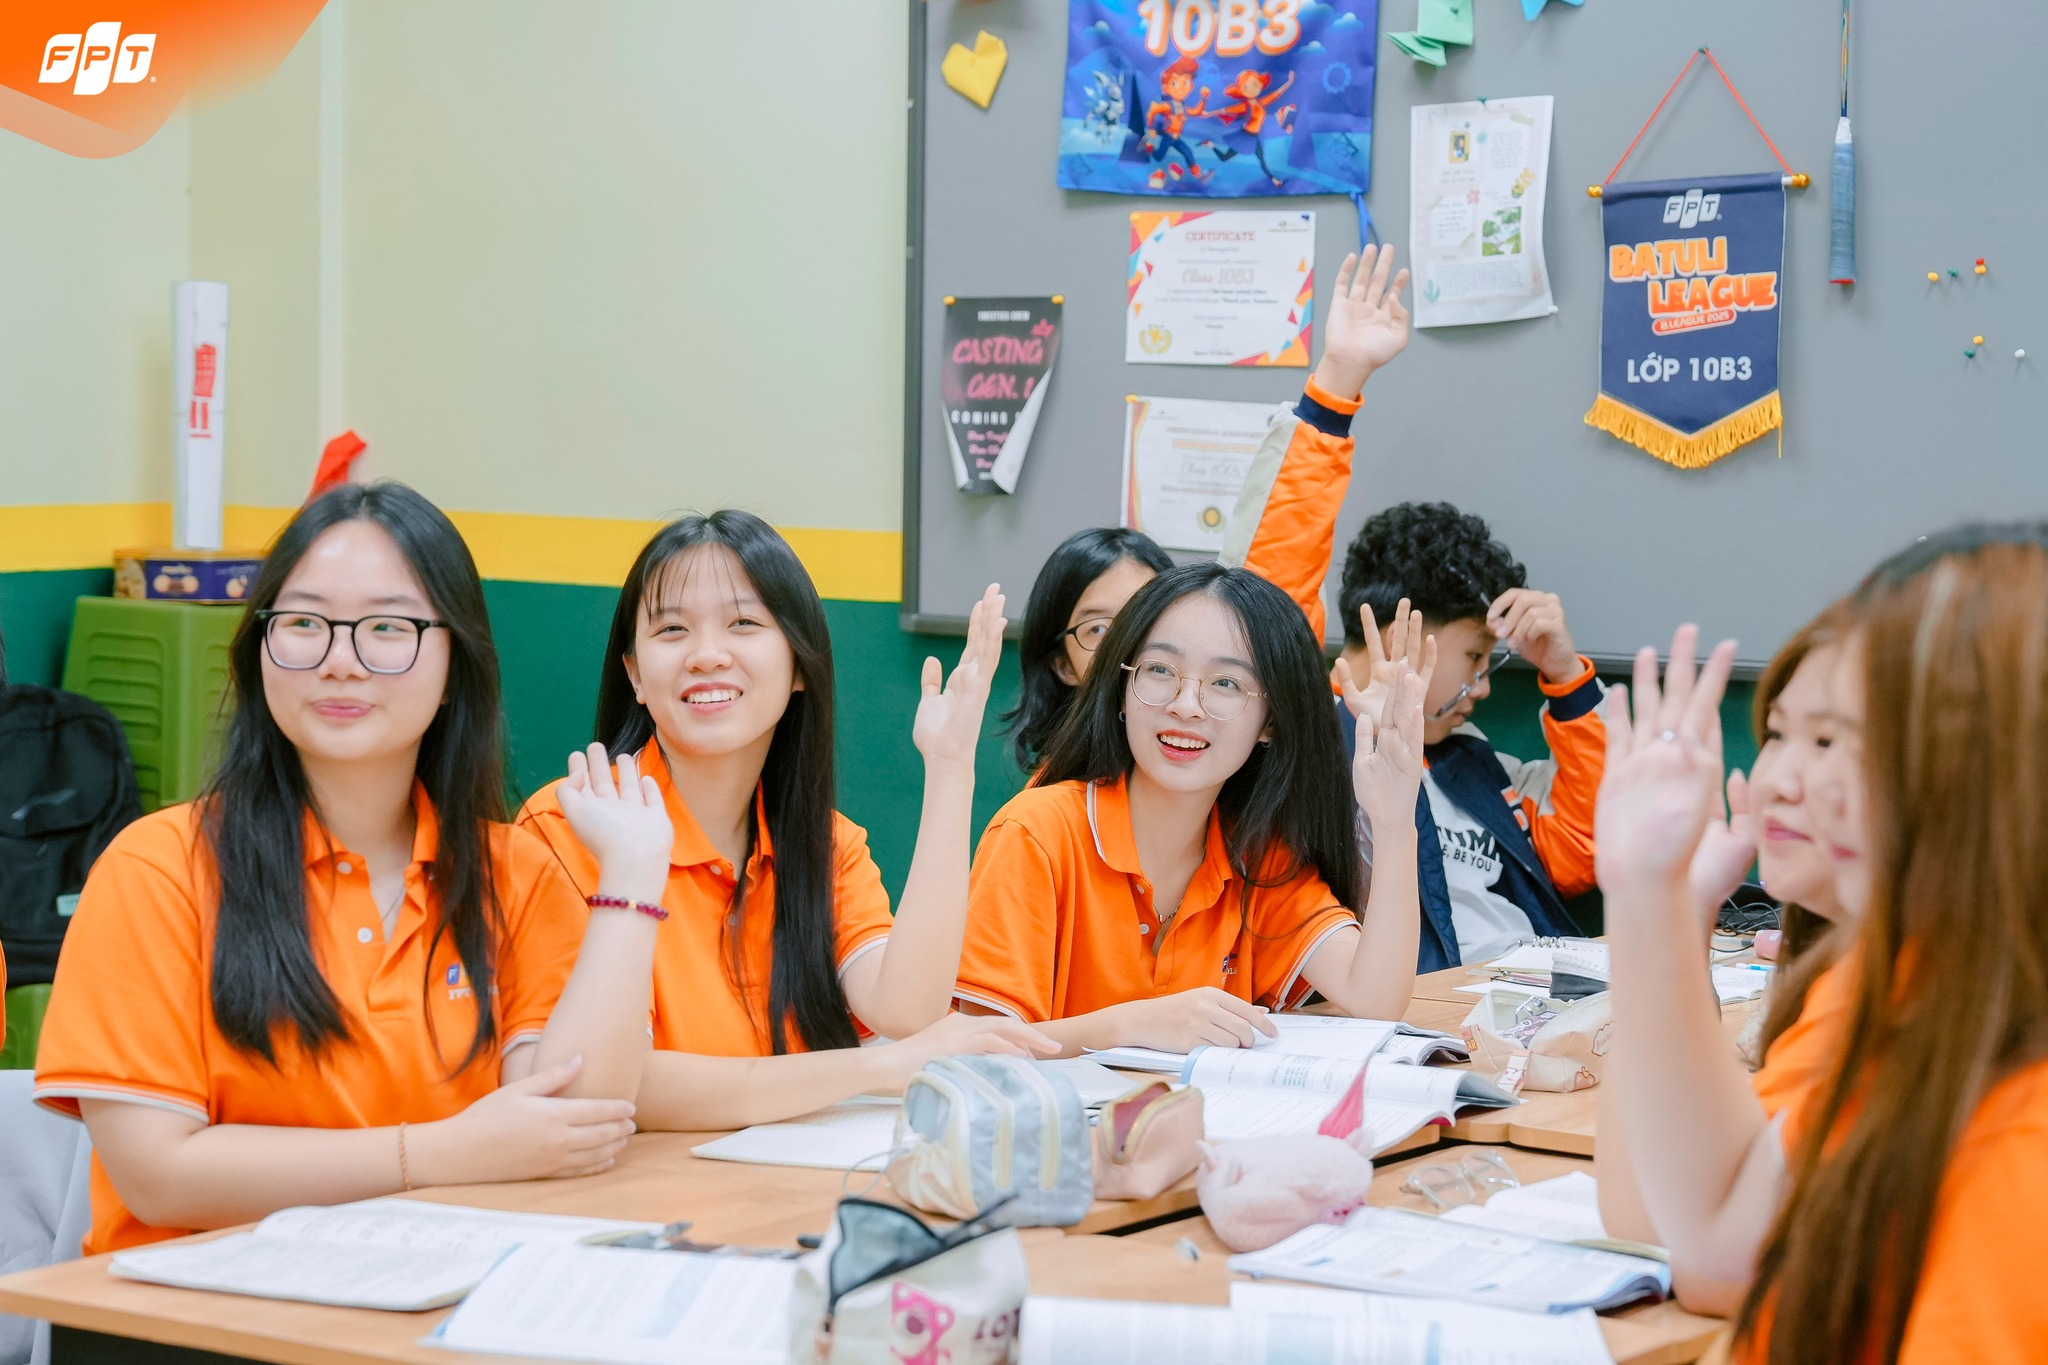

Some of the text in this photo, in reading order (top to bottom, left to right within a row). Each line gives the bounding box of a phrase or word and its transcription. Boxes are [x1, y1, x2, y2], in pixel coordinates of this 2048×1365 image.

[1138, 0, 1300, 57] 10B3
[1663, 189, 1722, 229] FPT
[1185, 230, 1256, 242] CERTIFICATE
[1609, 236, 1728, 283] BATULI
[1648, 272, 1777, 319] LEAGUE
[1707, 311, 1730, 323] 2025
[952, 336, 1043, 365] CASTING
[1627, 352, 1753, 383] LỚP 10B3
[1453, 849, 1467, 863] BE
[1470, 854, 1492, 872] YOU
